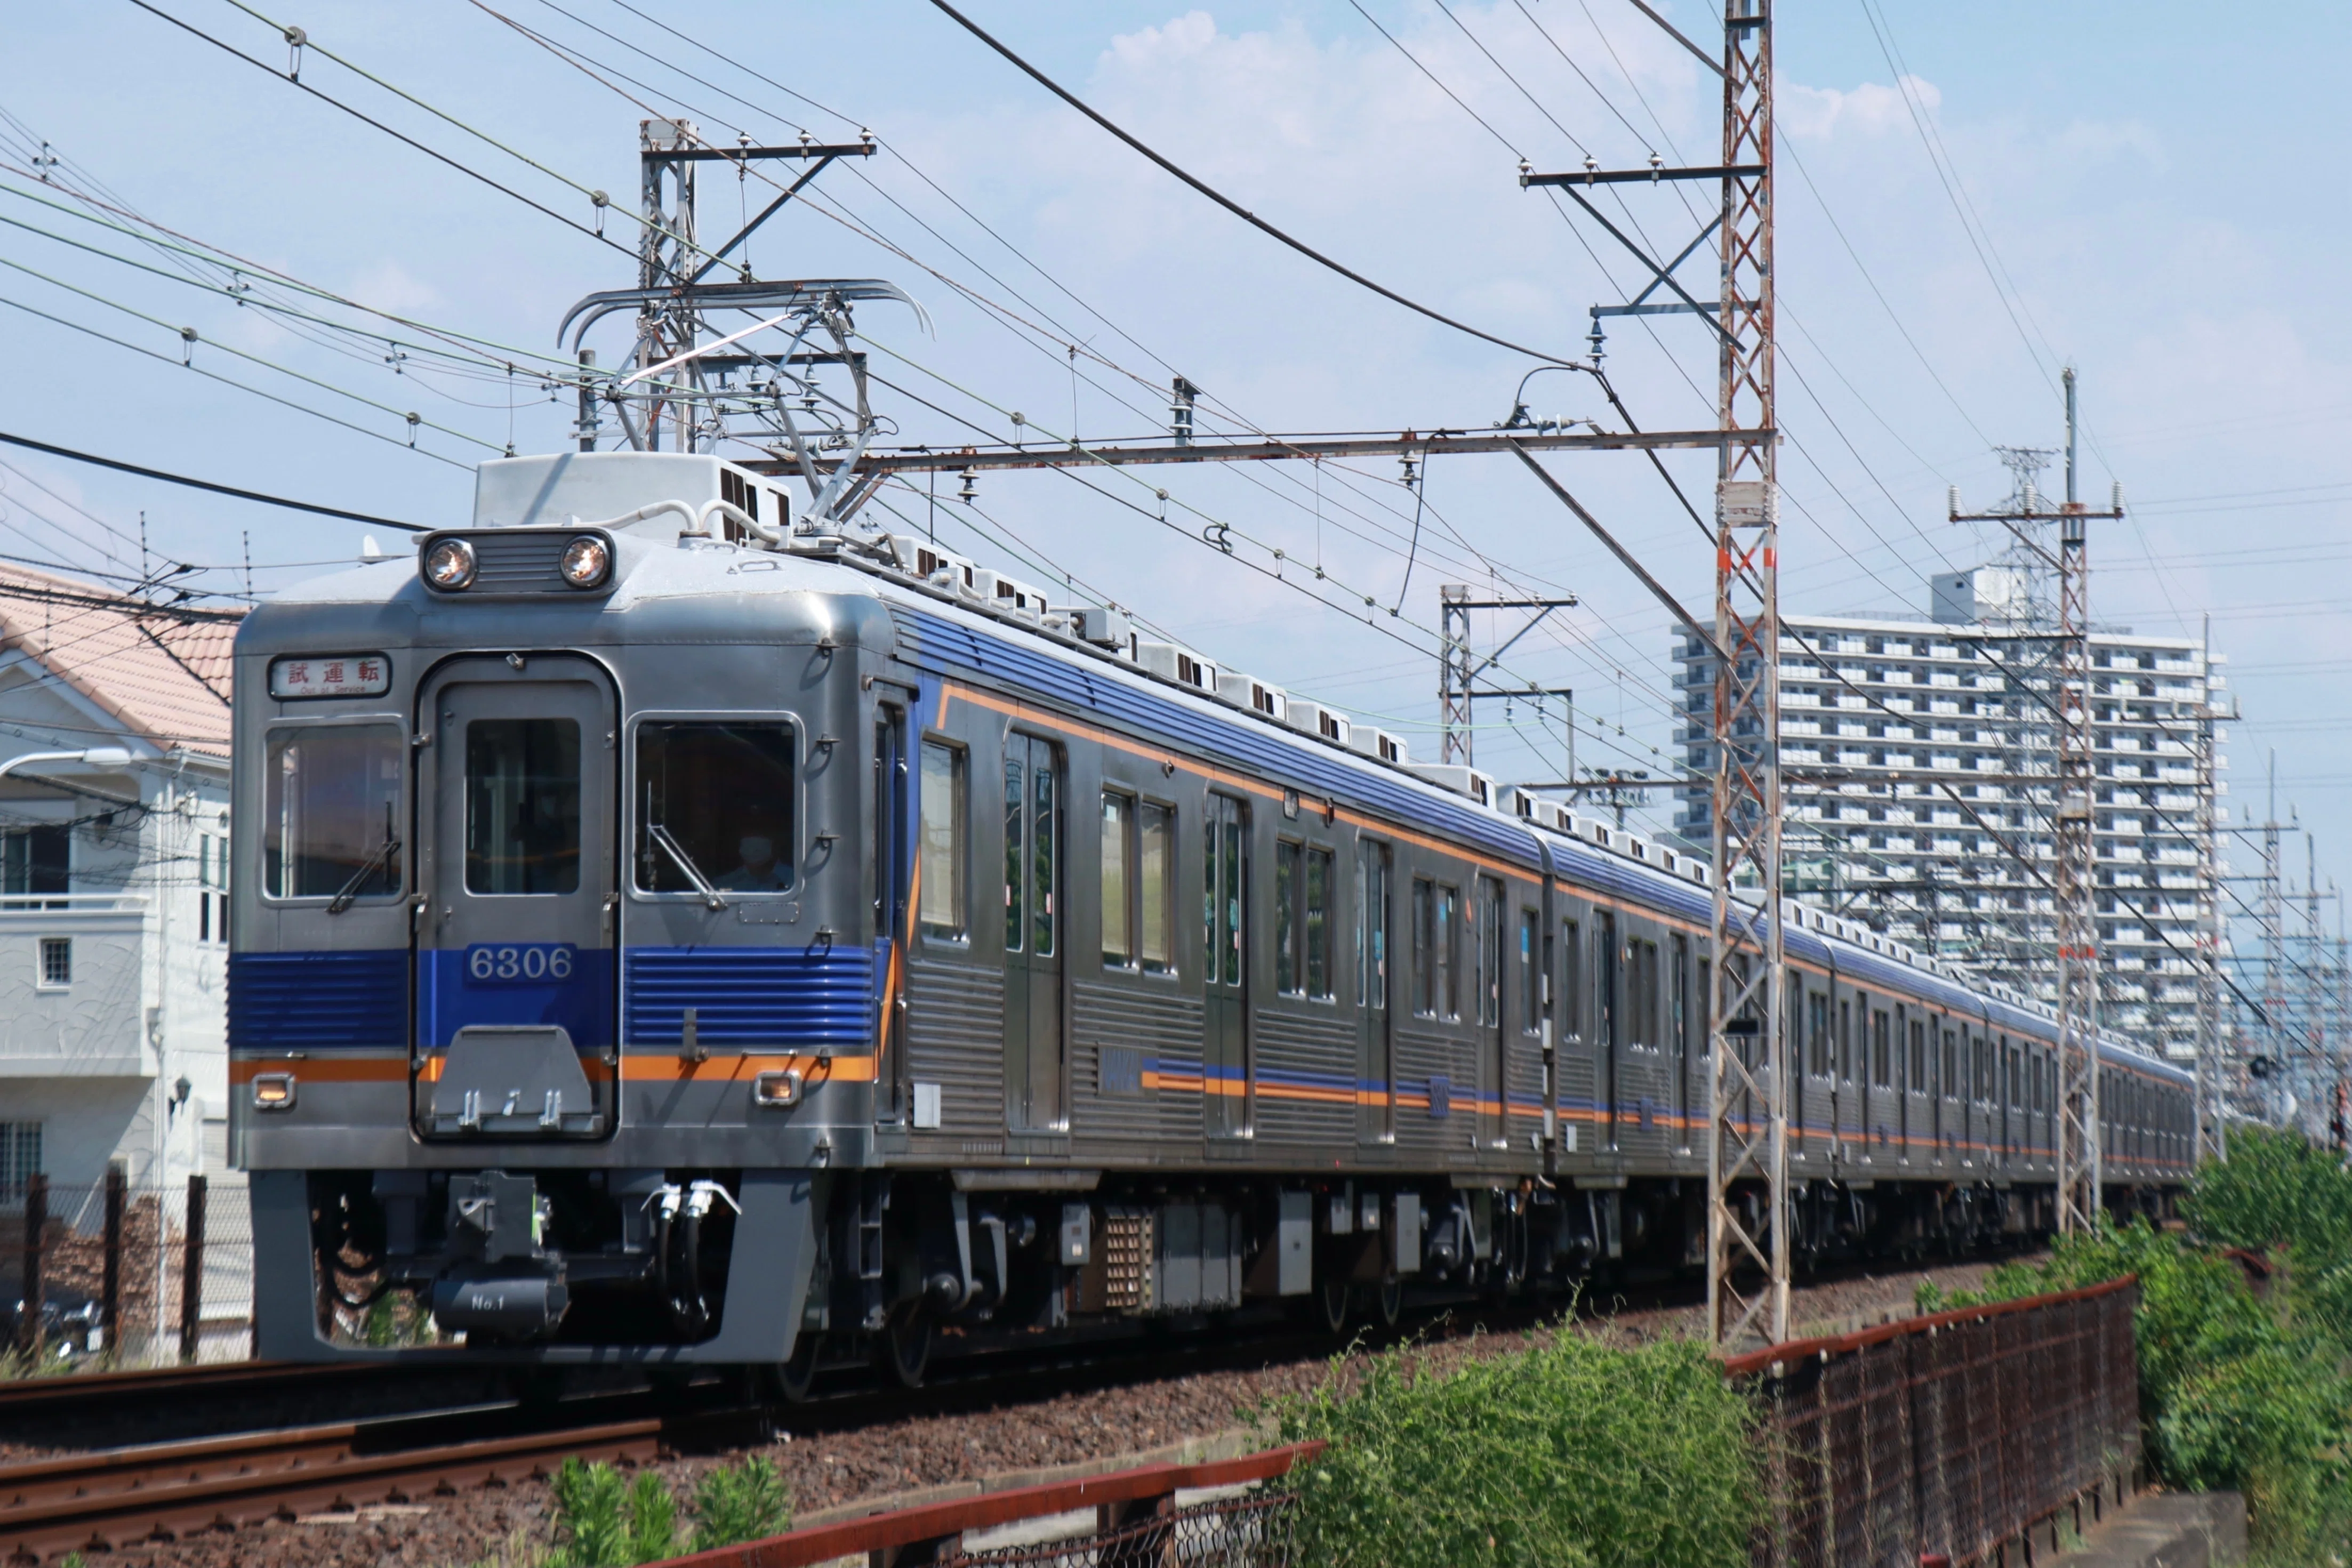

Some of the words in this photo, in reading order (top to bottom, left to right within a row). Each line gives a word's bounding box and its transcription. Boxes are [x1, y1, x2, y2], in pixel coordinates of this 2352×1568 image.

[288, 661, 379, 685] 試運転
[334, 686, 366, 694] Service
[470, 947, 572, 979] 6306
[472, 1294, 504, 1310] No.1
